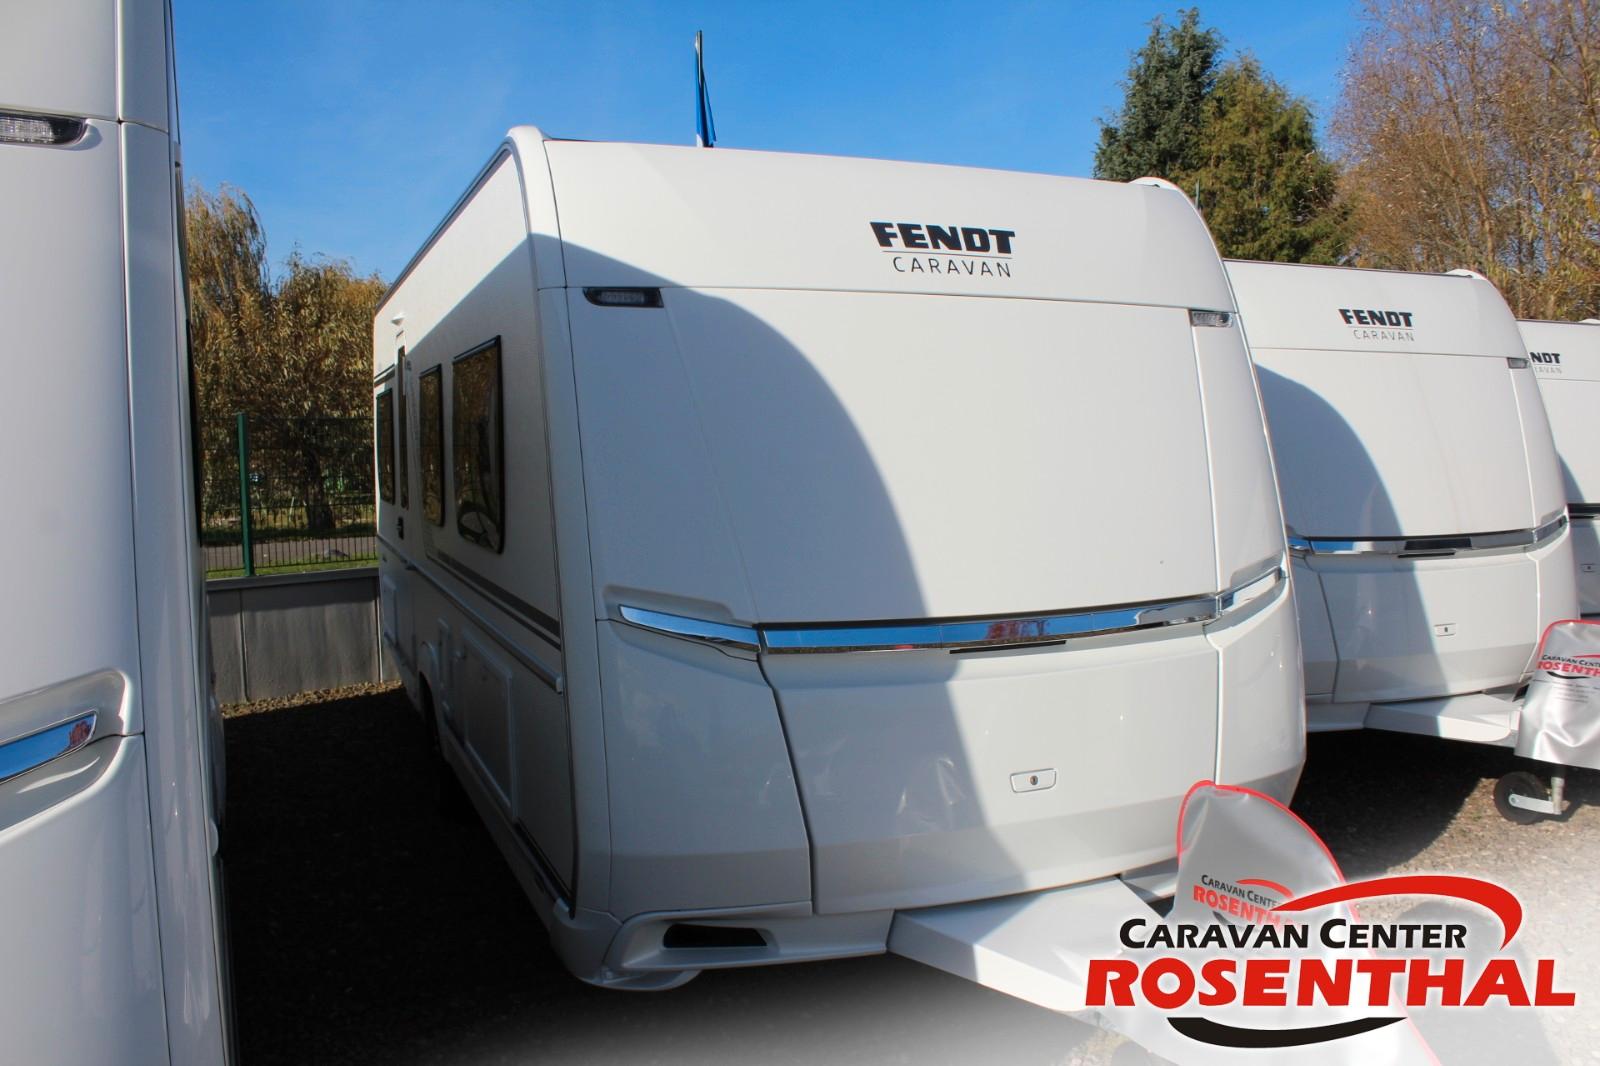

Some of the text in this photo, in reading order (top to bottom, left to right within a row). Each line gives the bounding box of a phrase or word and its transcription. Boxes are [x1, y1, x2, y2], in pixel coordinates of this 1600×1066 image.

[870, 221, 1016, 254] FENDT
[893, 256, 1011, 277] CARAVAN
[1338, 308, 1413, 327] FENDT
[1353, 329, 1415, 341] CARAVAN
[1529, 351, 1560, 364] NDT
[1200, 874, 1279, 908] CARAVAN CENTE
